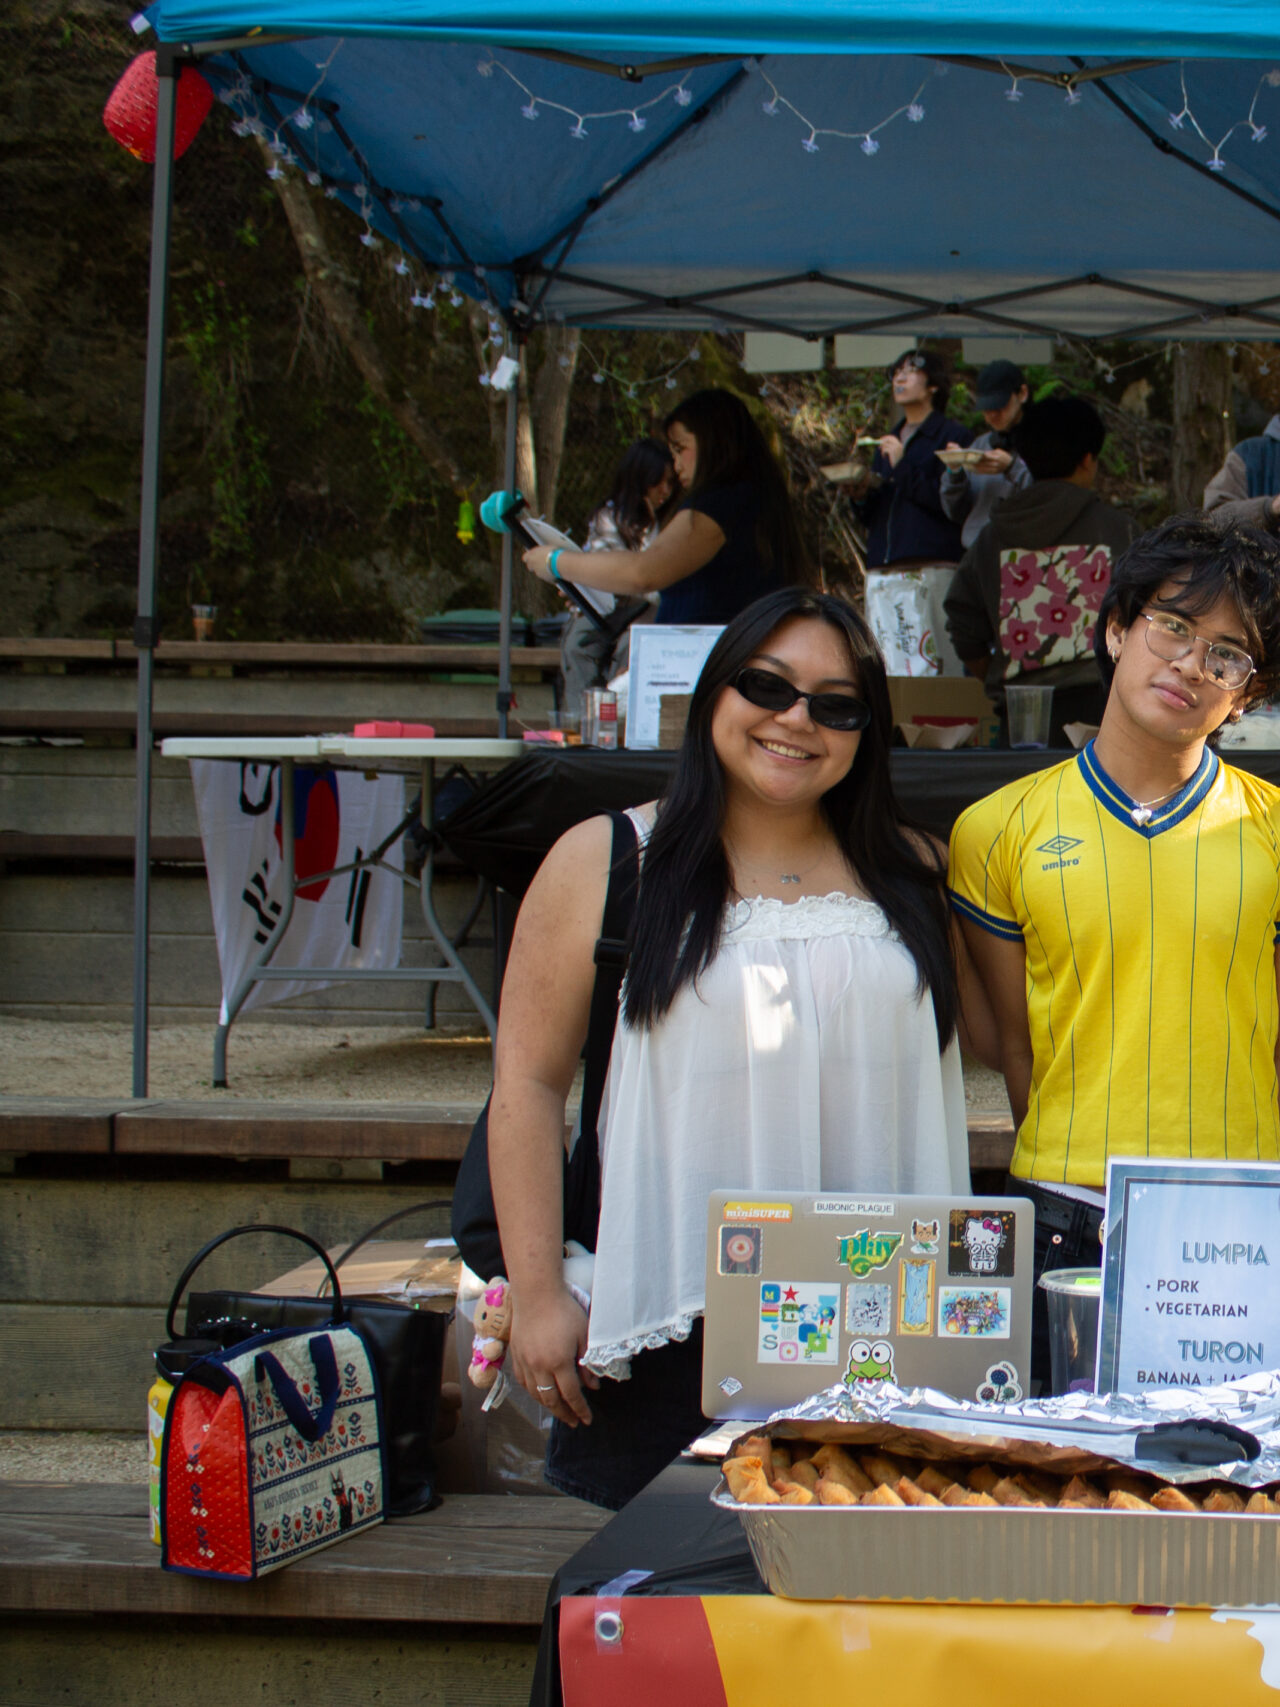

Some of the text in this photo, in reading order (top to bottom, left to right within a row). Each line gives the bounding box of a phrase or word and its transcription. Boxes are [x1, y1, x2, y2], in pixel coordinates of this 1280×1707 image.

[1042, 858, 1079, 871] umbro
[725, 1206, 791, 1219] miniSUPER
[816, 1202, 893, 1213] BUBONIC PLAGUE
[1182, 1241, 1269, 1265] LUMPIA
[1156, 1279, 1199, 1293] PORK
[1156, 1302, 1248, 1317] VEGETARIAN
[1177, 1339, 1264, 1364] TURON
[1136, 1370, 1201, 1385] BANANA
